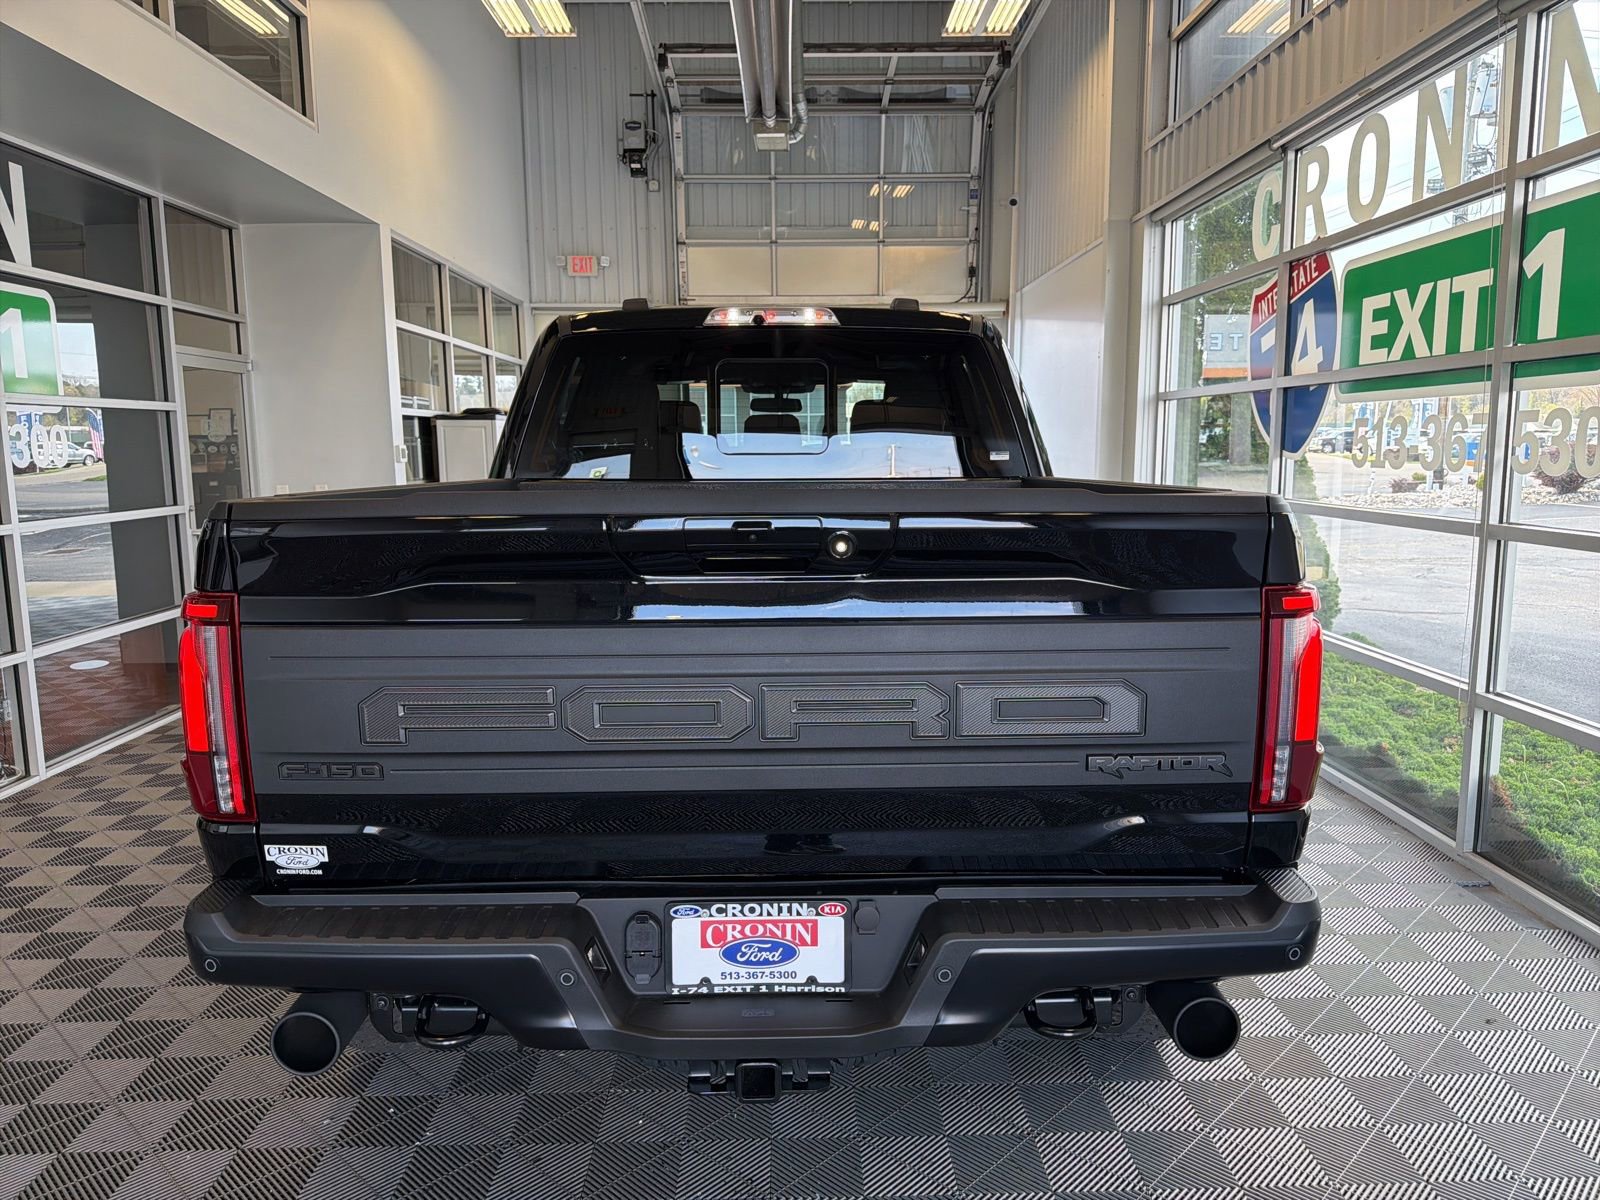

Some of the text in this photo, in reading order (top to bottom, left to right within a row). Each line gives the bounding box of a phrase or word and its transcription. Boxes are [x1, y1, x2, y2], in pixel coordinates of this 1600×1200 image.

[572, 256, 592, 272] EXIT
[1259, 256, 1319, 322] INTETATE
[1358, 228, 1565, 365] EXIT 1
[359, 678, 1146, 745] FORD
[278, 762, 384, 780] F-150
[1086, 752, 1233, 779] RAPTOR
[267, 847, 325, 858] CRONIN
[286, 857, 309, 865] Ford
[676, 907, 695, 916] Ford
[710, 902, 808, 917] CRONIN
[823, 906, 843, 915] KIA
[706, 923, 813, 947] CRONIN
[737, 943, 783, 962] Ford
[720, 970, 797, 981] 513-367-5300
[672, 985, 846, 996] I-74 EXIT 1 Harrison
